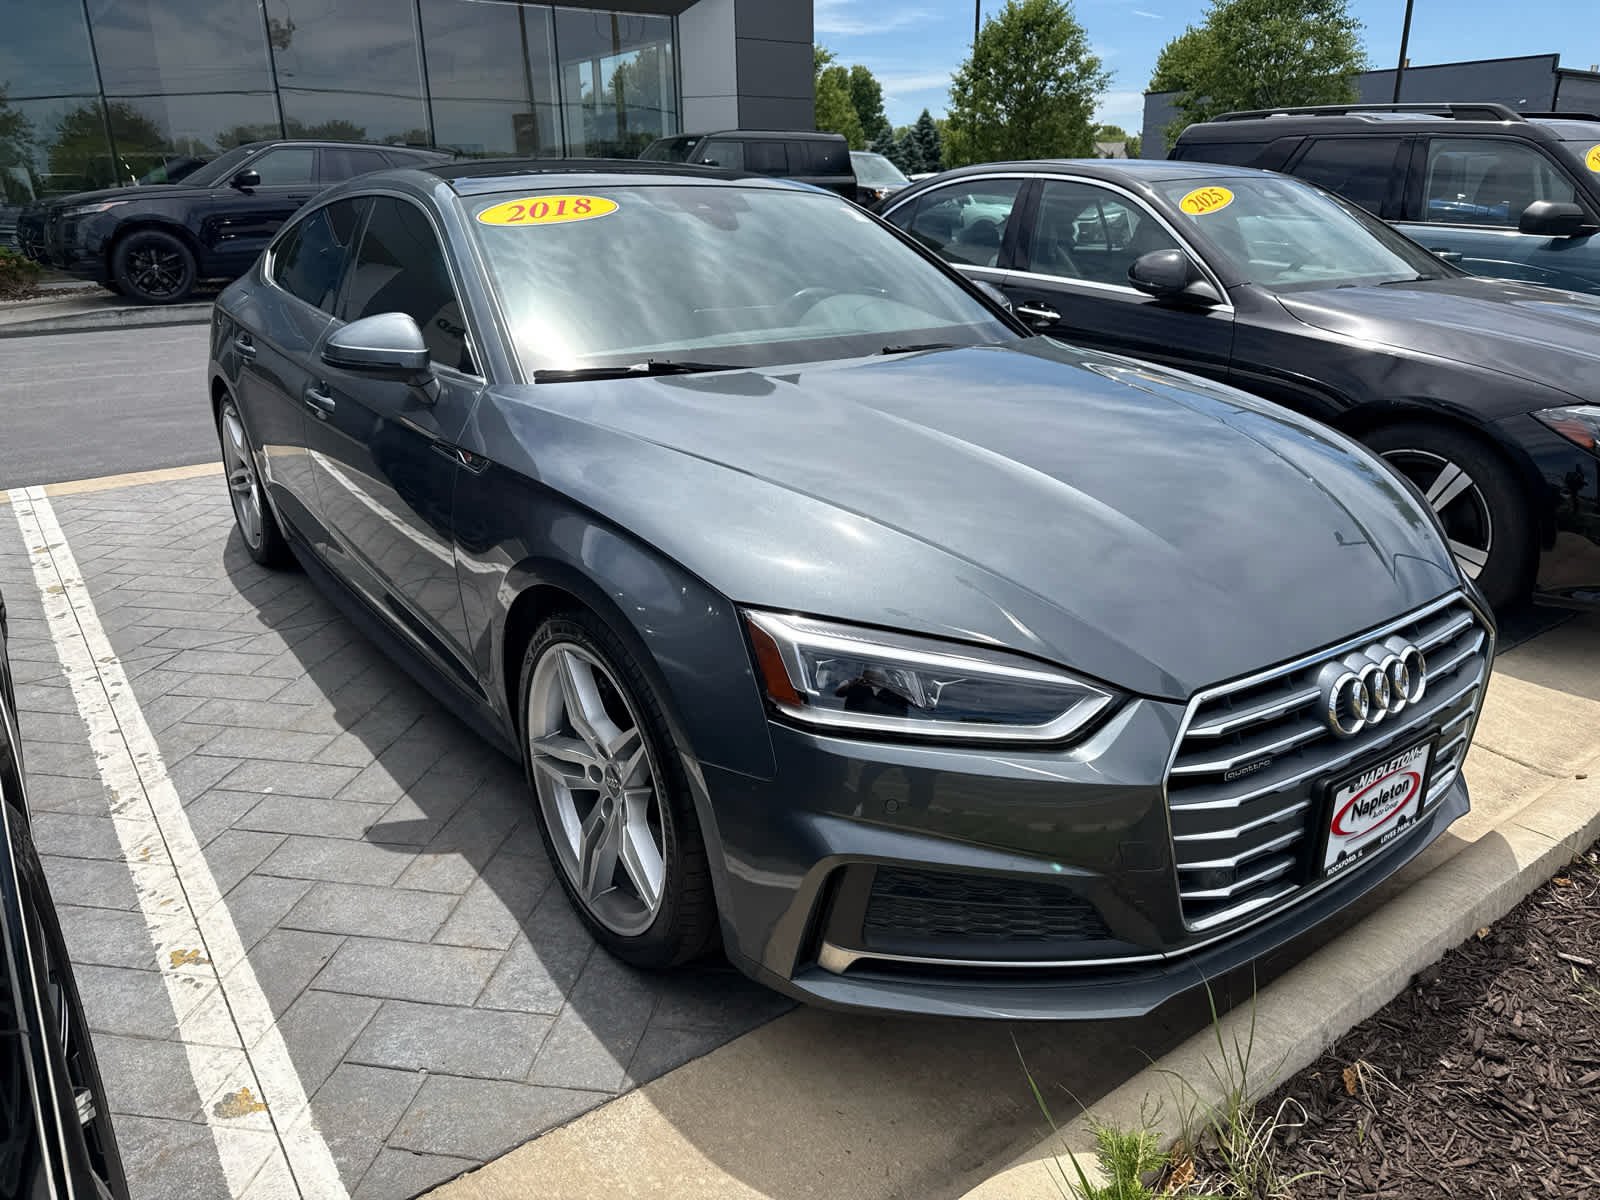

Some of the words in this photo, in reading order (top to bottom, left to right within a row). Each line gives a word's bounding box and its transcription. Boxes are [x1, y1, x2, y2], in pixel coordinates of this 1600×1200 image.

[507, 198, 592, 222] 2018
[1187, 188, 1224, 212] 2025
[1227, 759, 1271, 779] quattro
[1351, 779, 1410, 822] Napleton
